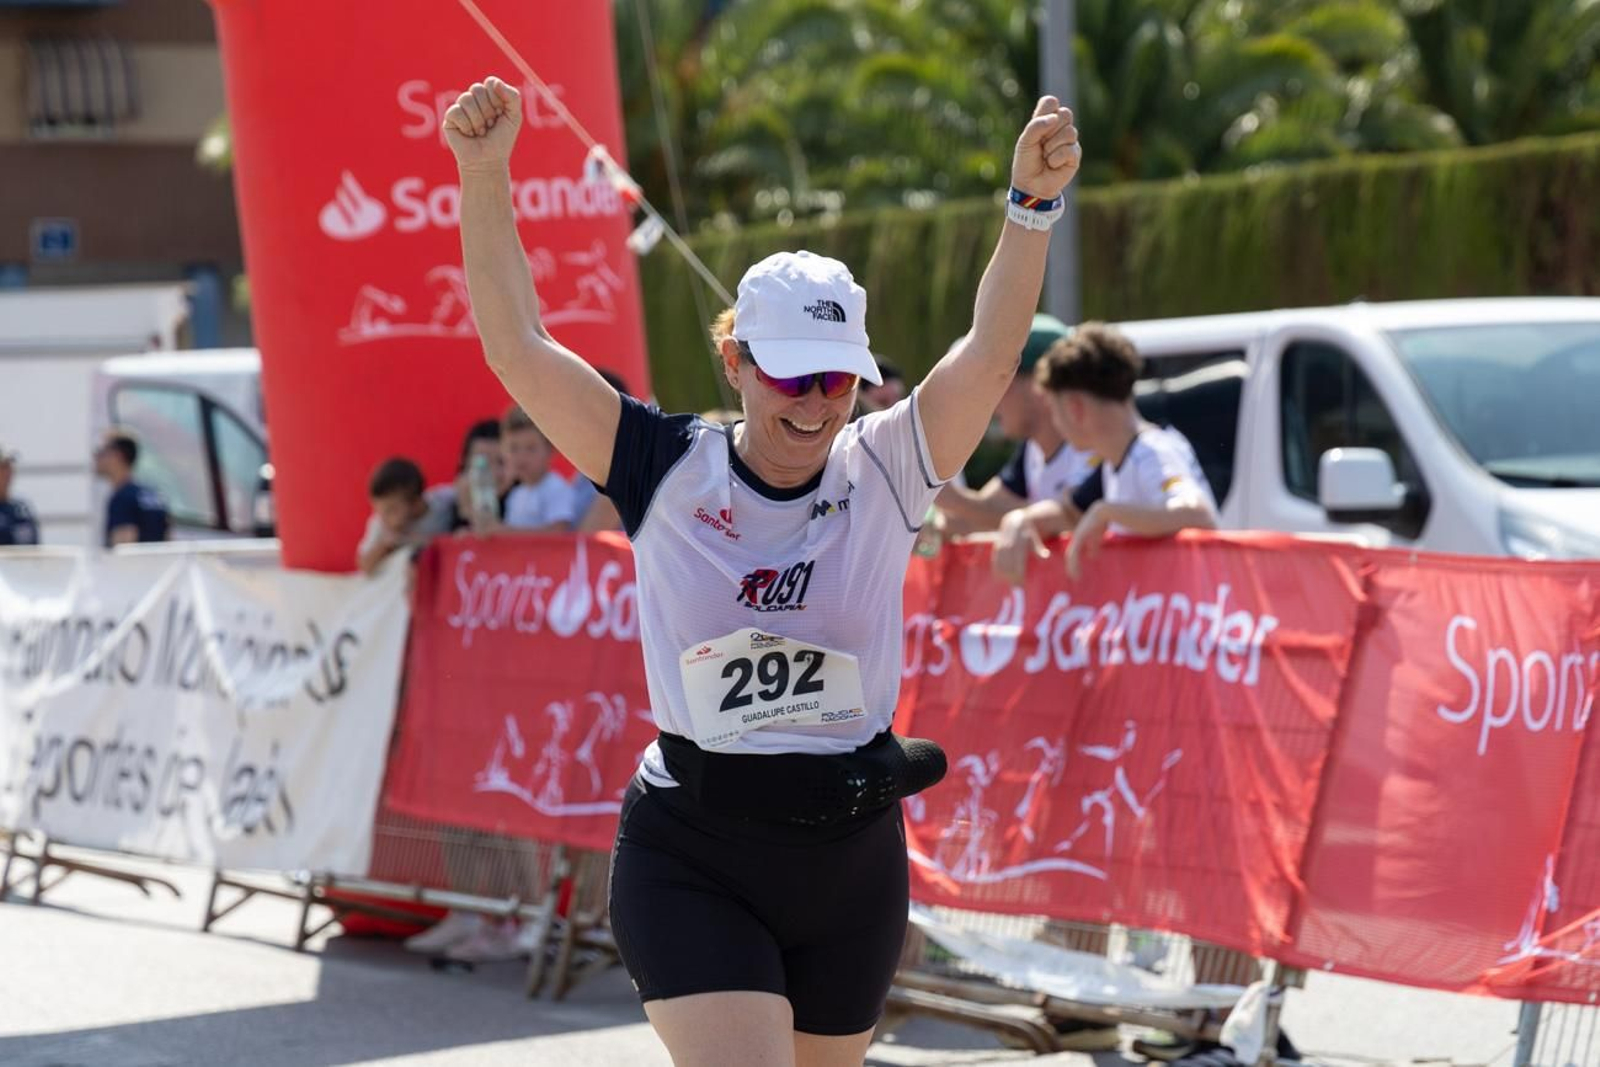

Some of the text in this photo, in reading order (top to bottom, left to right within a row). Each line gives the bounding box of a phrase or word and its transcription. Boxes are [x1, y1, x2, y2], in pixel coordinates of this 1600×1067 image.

[816, 299, 832, 307] THE
[803, 305, 833, 315] NORTH
[812, 313, 833, 321] FACE
[719, 649, 825, 712] 292
[741, 700, 819, 724] GUADALUPE CASTILLO
